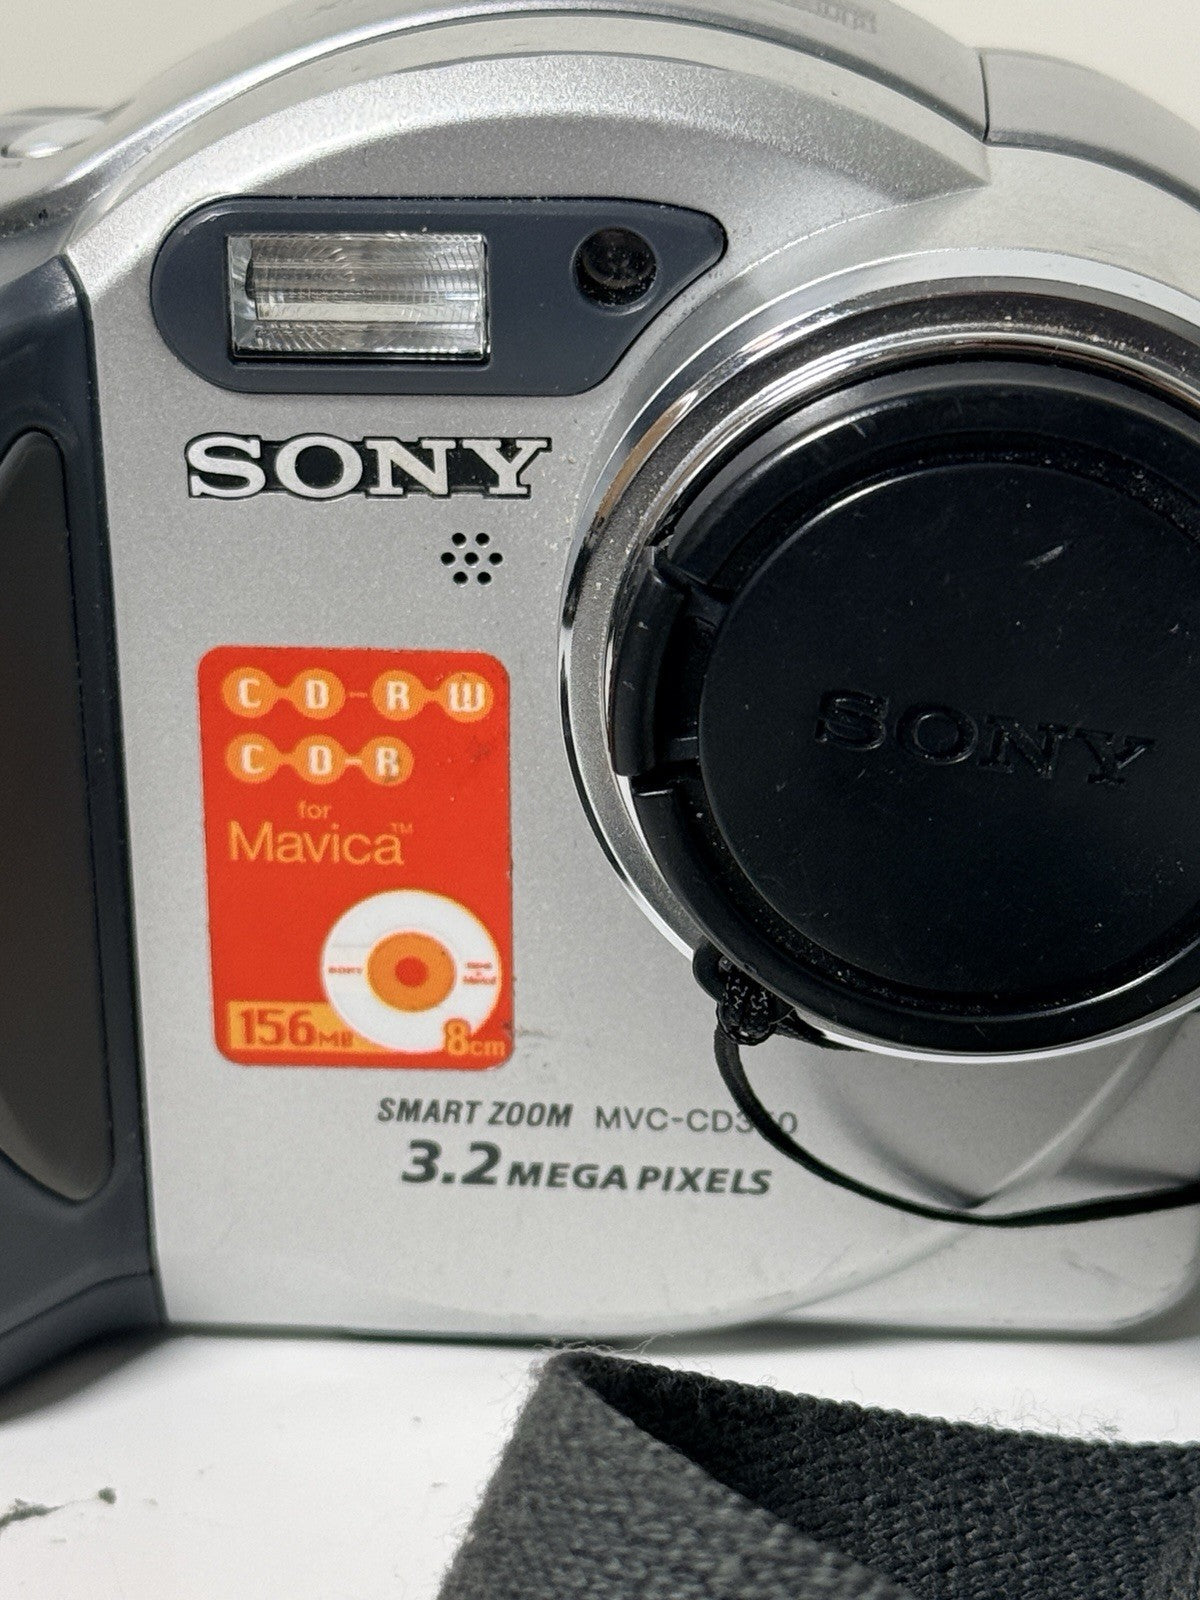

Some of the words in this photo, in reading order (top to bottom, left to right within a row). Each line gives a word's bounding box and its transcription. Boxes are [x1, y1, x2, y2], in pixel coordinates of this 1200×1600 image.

[185, 433, 552, 499] SONY
[815, 690, 1155, 787] SONY
[240, 743, 401, 777] CD-R
[298, 800, 331, 819] for
[445, 1019, 506, 1056] 8cm
[377, 1097, 482, 1125] SMART
[487, 1101, 574, 1128] ZOOM
[595, 1106, 799, 1134] MVC-CD30
[400, 1139, 503, 1186] 3.2
[506, 1161, 628, 1191] MEGA
[636, 1165, 773, 1196] PIXELS
